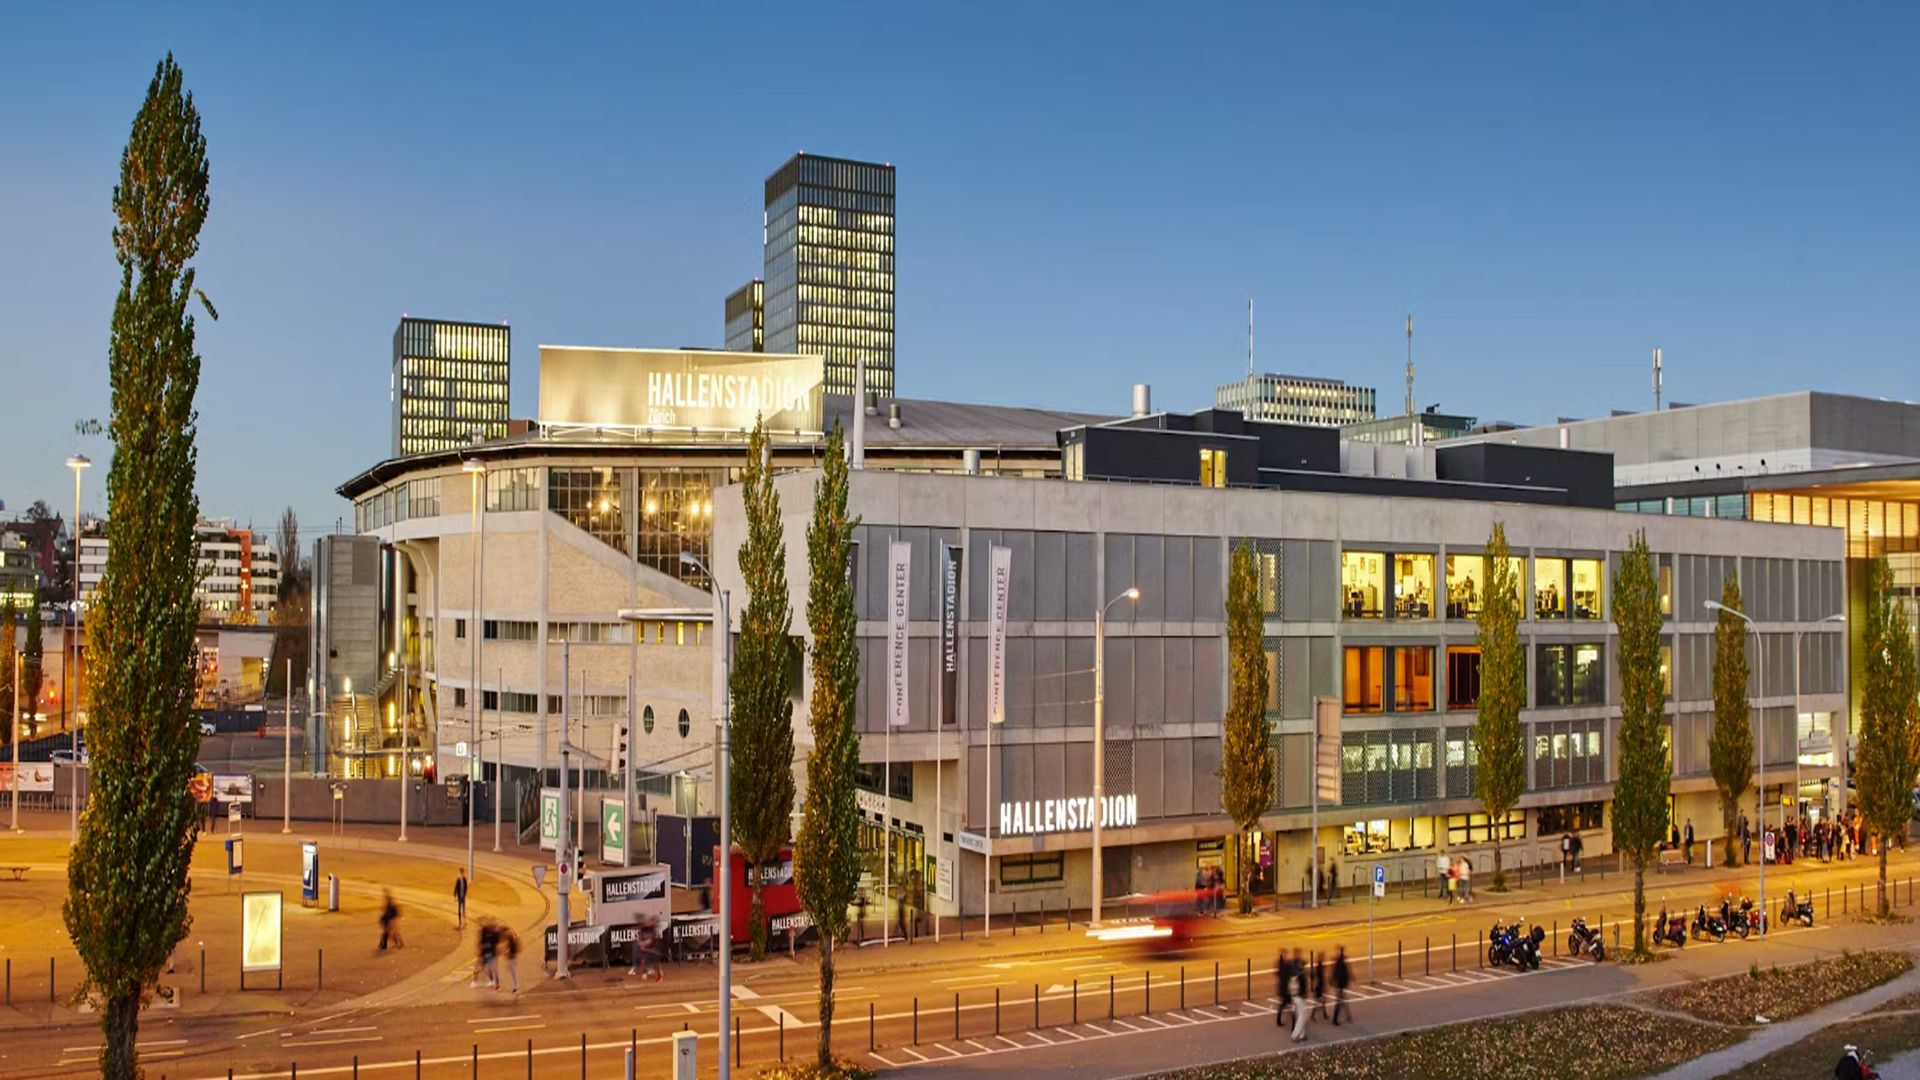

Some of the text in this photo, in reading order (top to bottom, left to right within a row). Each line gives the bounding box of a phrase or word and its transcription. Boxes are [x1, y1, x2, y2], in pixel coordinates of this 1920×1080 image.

[648, 371, 810, 412] HALLENSTADION
[648, 408, 676, 424] Zürich
[896, 562, 906, 617] CENTER
[996, 566, 1005, 620] CENTER
[946, 560, 957, 672] HALLENSTADION
[606, 879, 661, 896] HALLENSTADION
[1377, 868, 1383, 881] P
